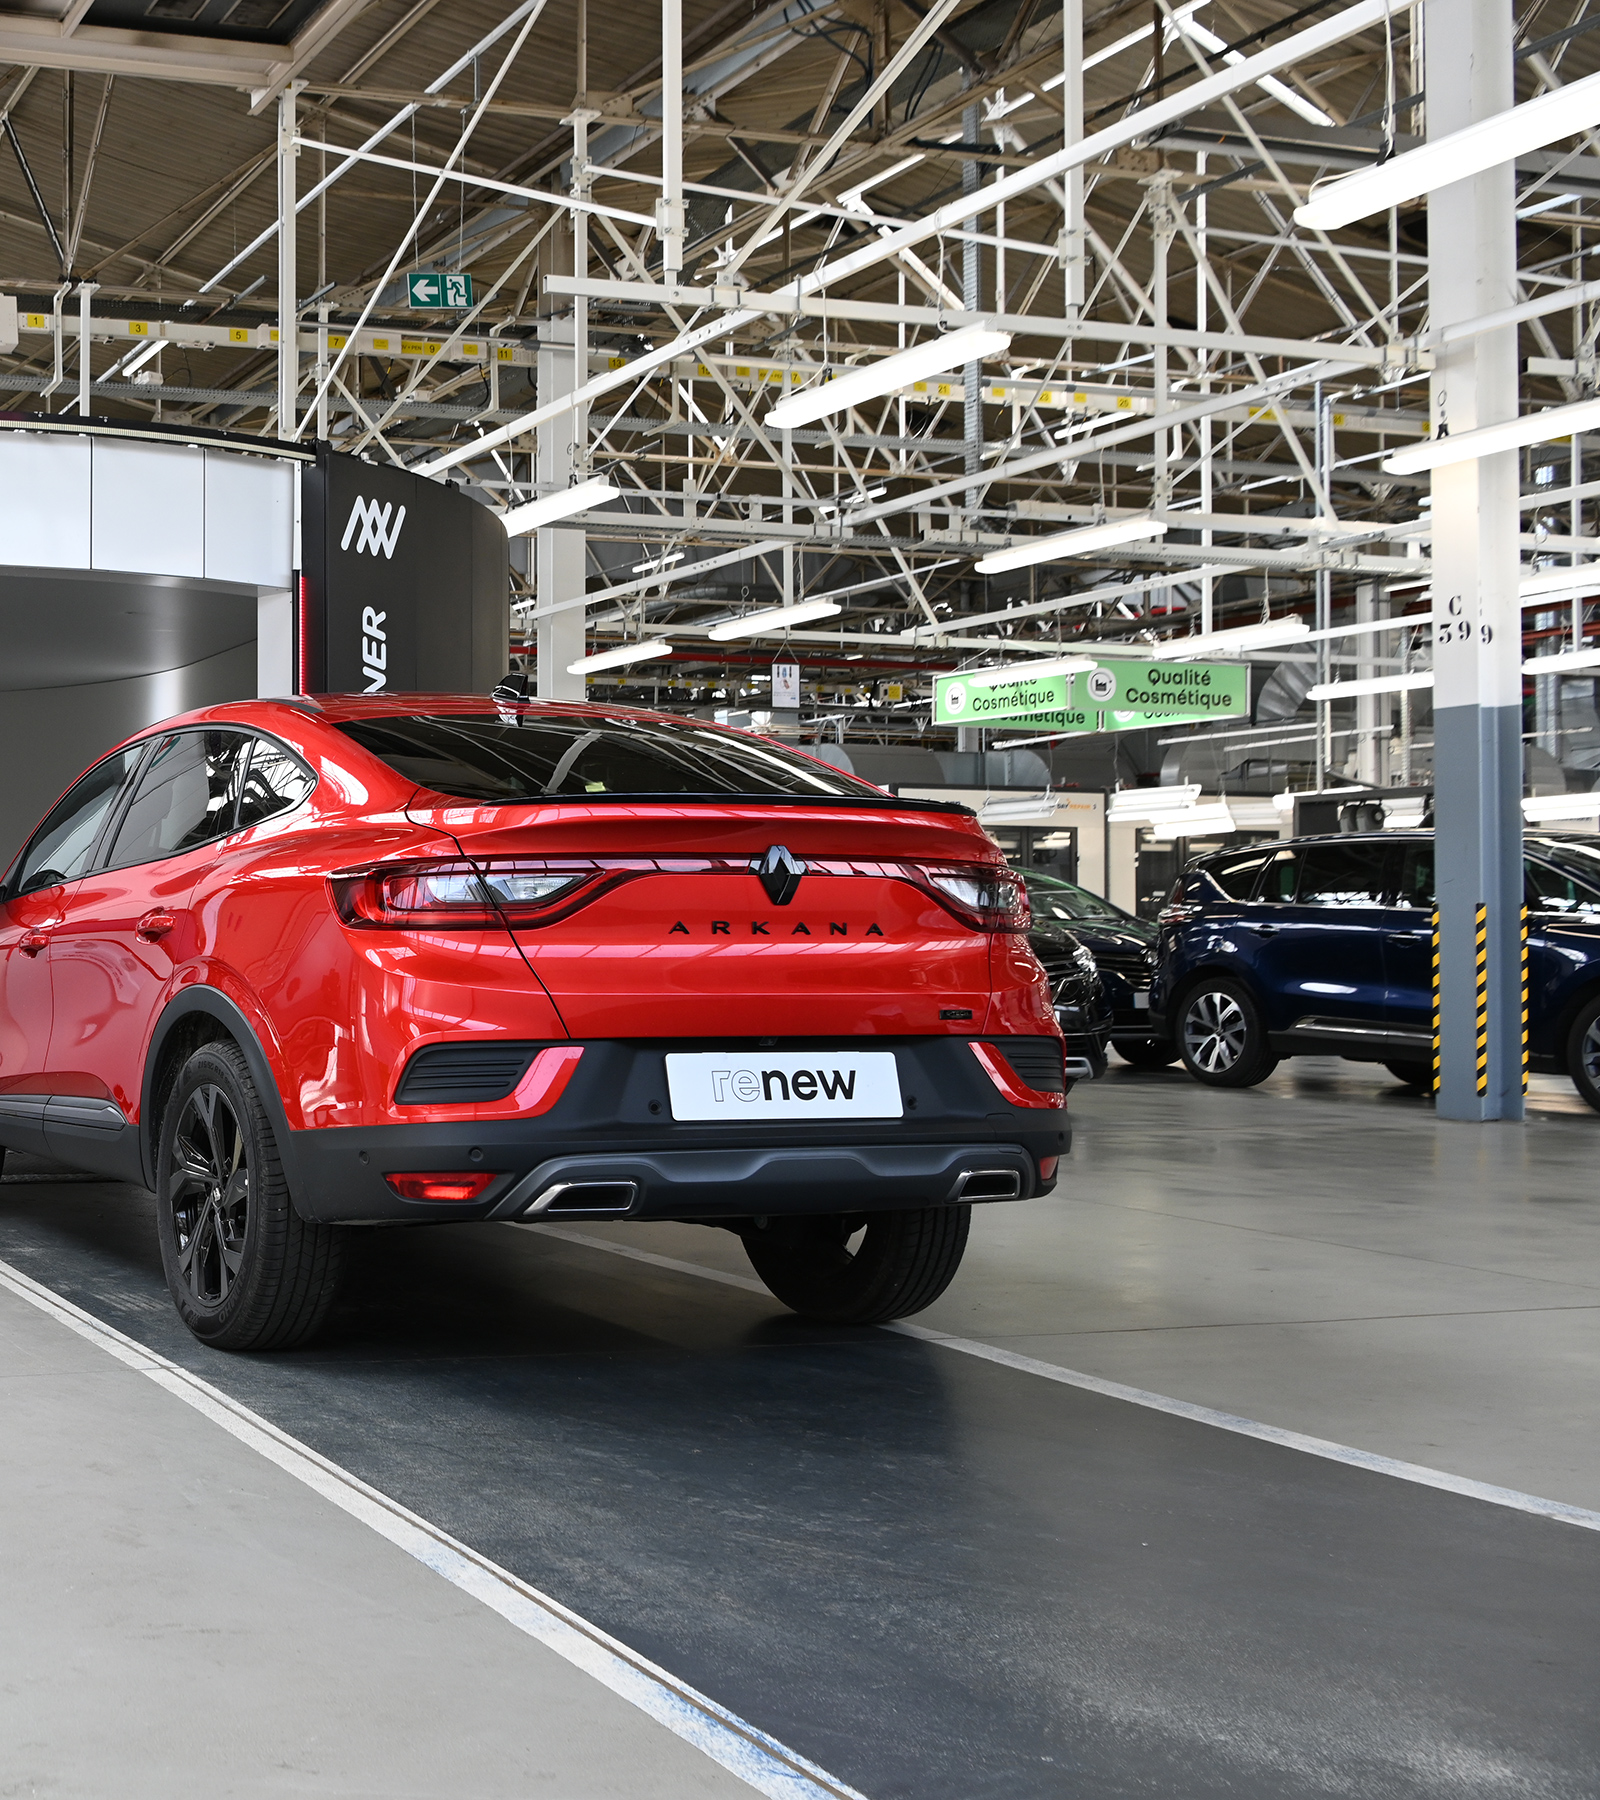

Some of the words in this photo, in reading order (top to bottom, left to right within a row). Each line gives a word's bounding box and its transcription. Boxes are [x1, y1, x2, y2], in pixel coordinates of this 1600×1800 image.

[135, 324, 142, 333] 3
[235, 331, 242, 340] 5
[333, 338, 339, 346] 7
[429, 345, 436, 354] 9
[499, 350, 508, 358] 11
[611, 359, 622, 368] 13
[938, 384, 947, 393] 21
[1119, 398, 1129, 408] 25
[1448, 595, 1462, 616] C
[1147, 668, 1212, 686] Qualité
[972, 690, 1055, 712] Cosmétique
[1126, 686, 1232, 708] Cosmétique
[668, 920, 885, 937] ARKANA
[710, 1069, 857, 1102] renew
